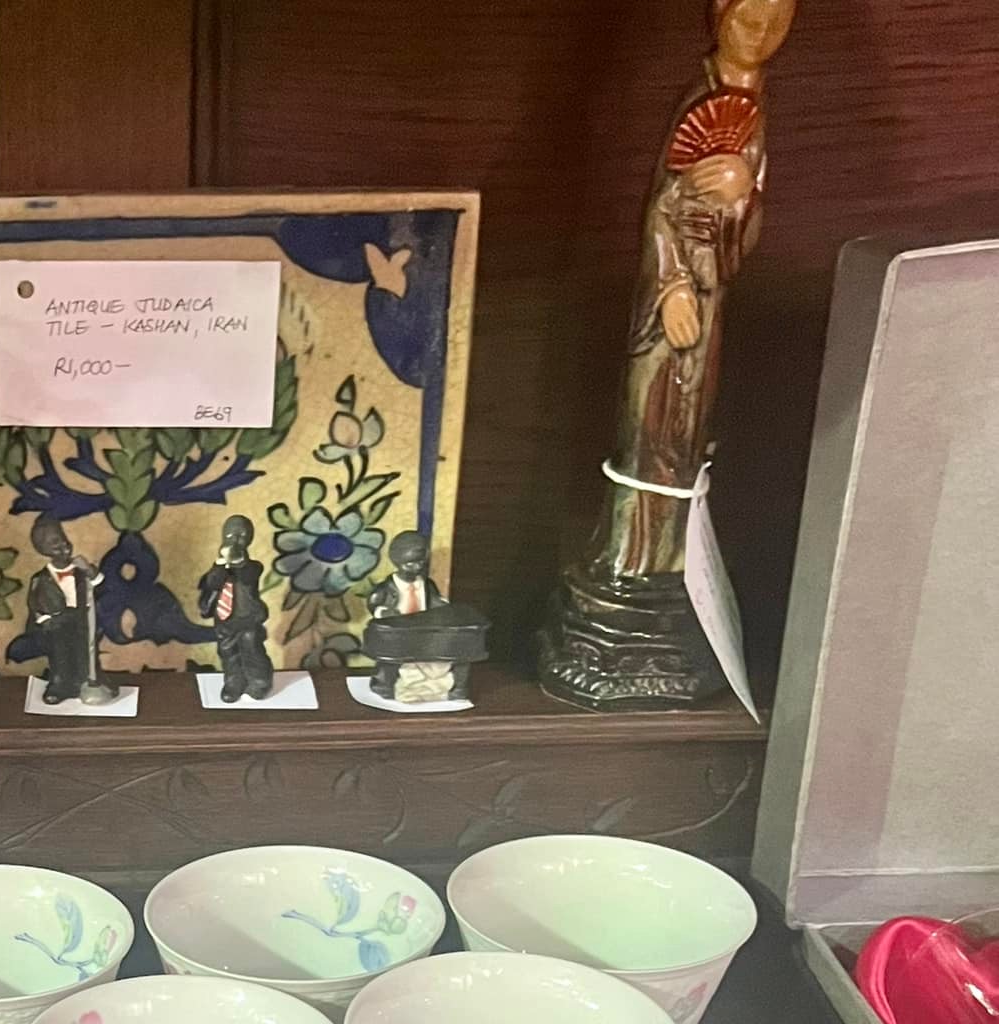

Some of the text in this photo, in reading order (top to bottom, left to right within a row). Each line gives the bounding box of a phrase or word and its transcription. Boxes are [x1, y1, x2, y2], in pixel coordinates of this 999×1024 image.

[45, 296, 215, 316] ANTIQUE JUDAICA
[46, 320, 90, 337] TILE
[122, 318, 199, 338] KASHAN,
[207, 315, 250, 333] IRAN
